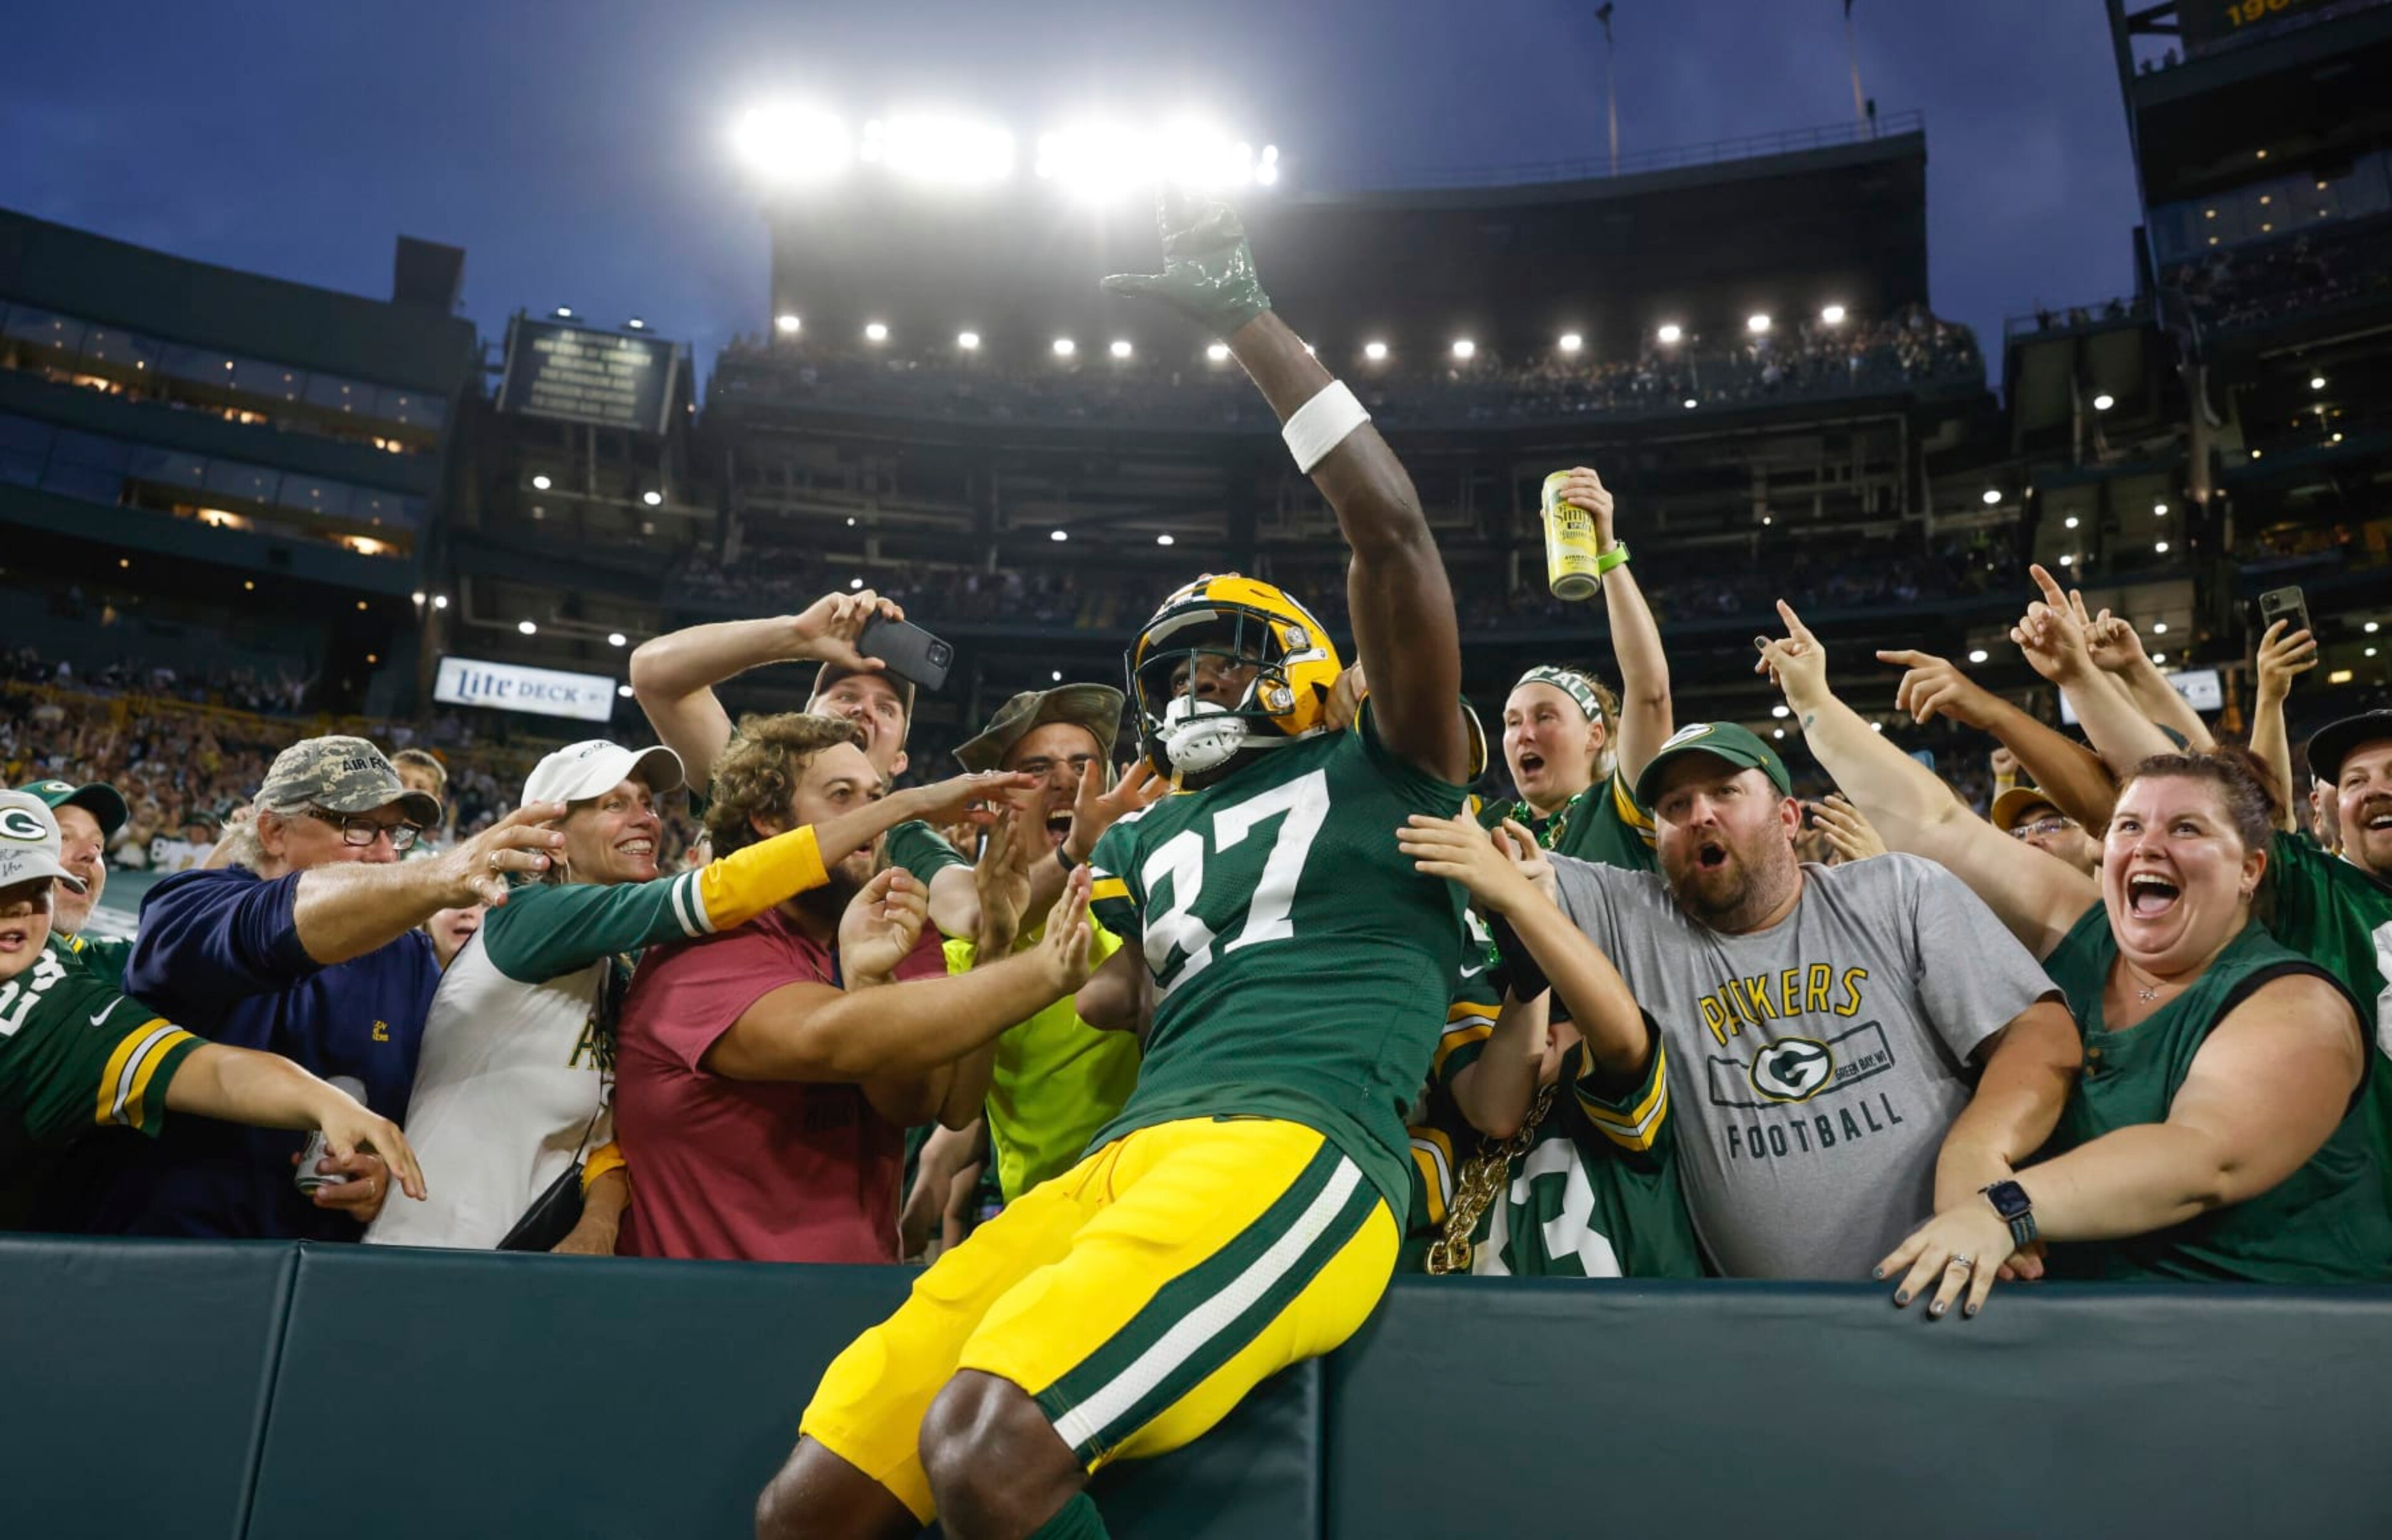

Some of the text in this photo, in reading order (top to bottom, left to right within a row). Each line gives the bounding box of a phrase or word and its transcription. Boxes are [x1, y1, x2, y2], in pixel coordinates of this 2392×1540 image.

[457, 669, 511, 702] Lite
[518, 681, 579, 702] DECK
[343, 758, 368, 772] AIR
[1141, 767, 1331, 996] 87
[1698, 963, 1868, 1048] PACKERS
[1834, 1062, 1859, 1080] GREEN
[1727, 1093, 1903, 1159] FOOTBALL
